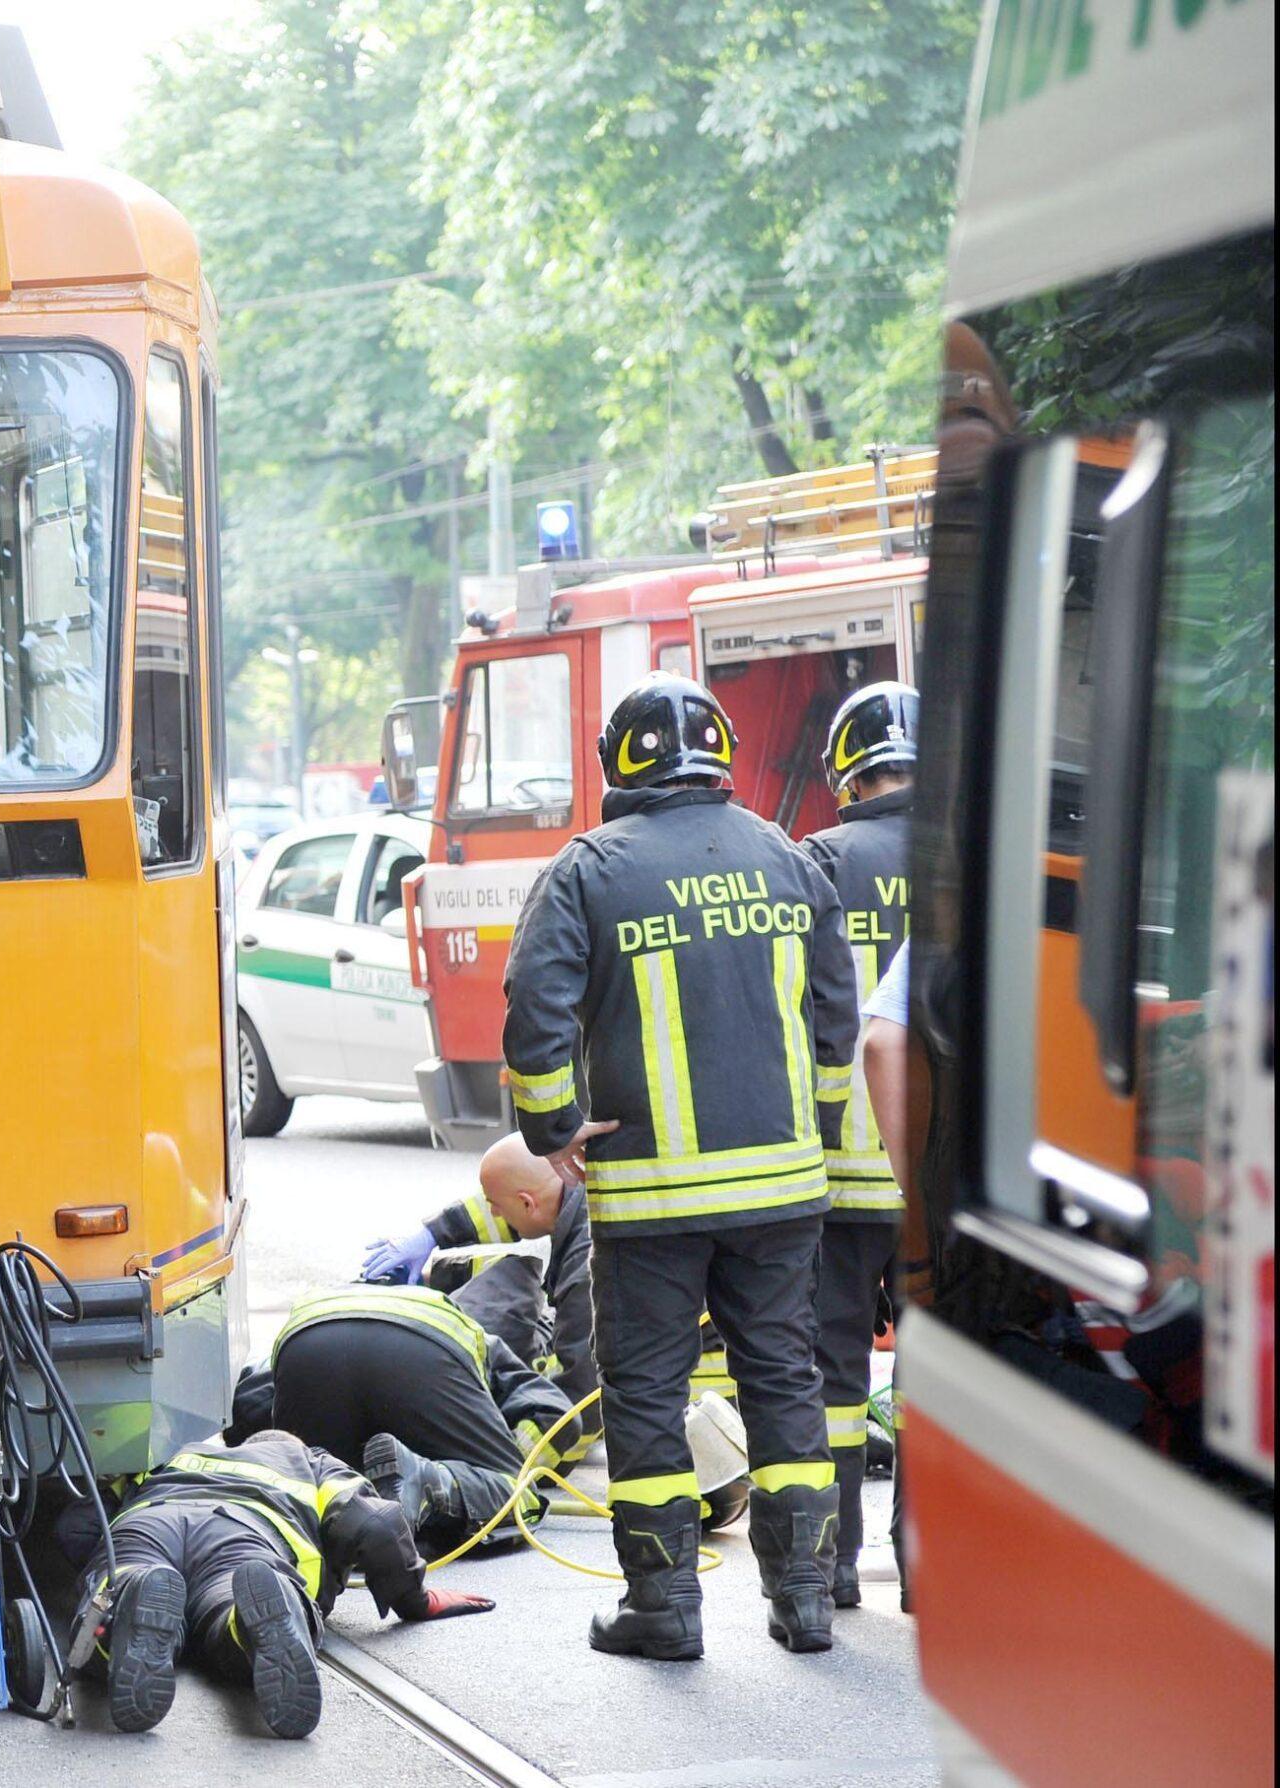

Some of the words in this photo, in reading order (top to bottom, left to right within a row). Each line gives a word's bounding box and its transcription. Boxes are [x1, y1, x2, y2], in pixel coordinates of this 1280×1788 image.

[434, 888, 471, 908] VIGILI
[476, 887, 504, 907] DEL
[509, 887, 527, 906] FU
[665, 870, 769, 908] VIGILI
[874, 876, 912, 906] VI
[616, 914, 691, 952] DEL
[701, 902, 812, 939] FUOCO
[846, 911, 892, 941] EL
[446, 930, 478, 963] 115
